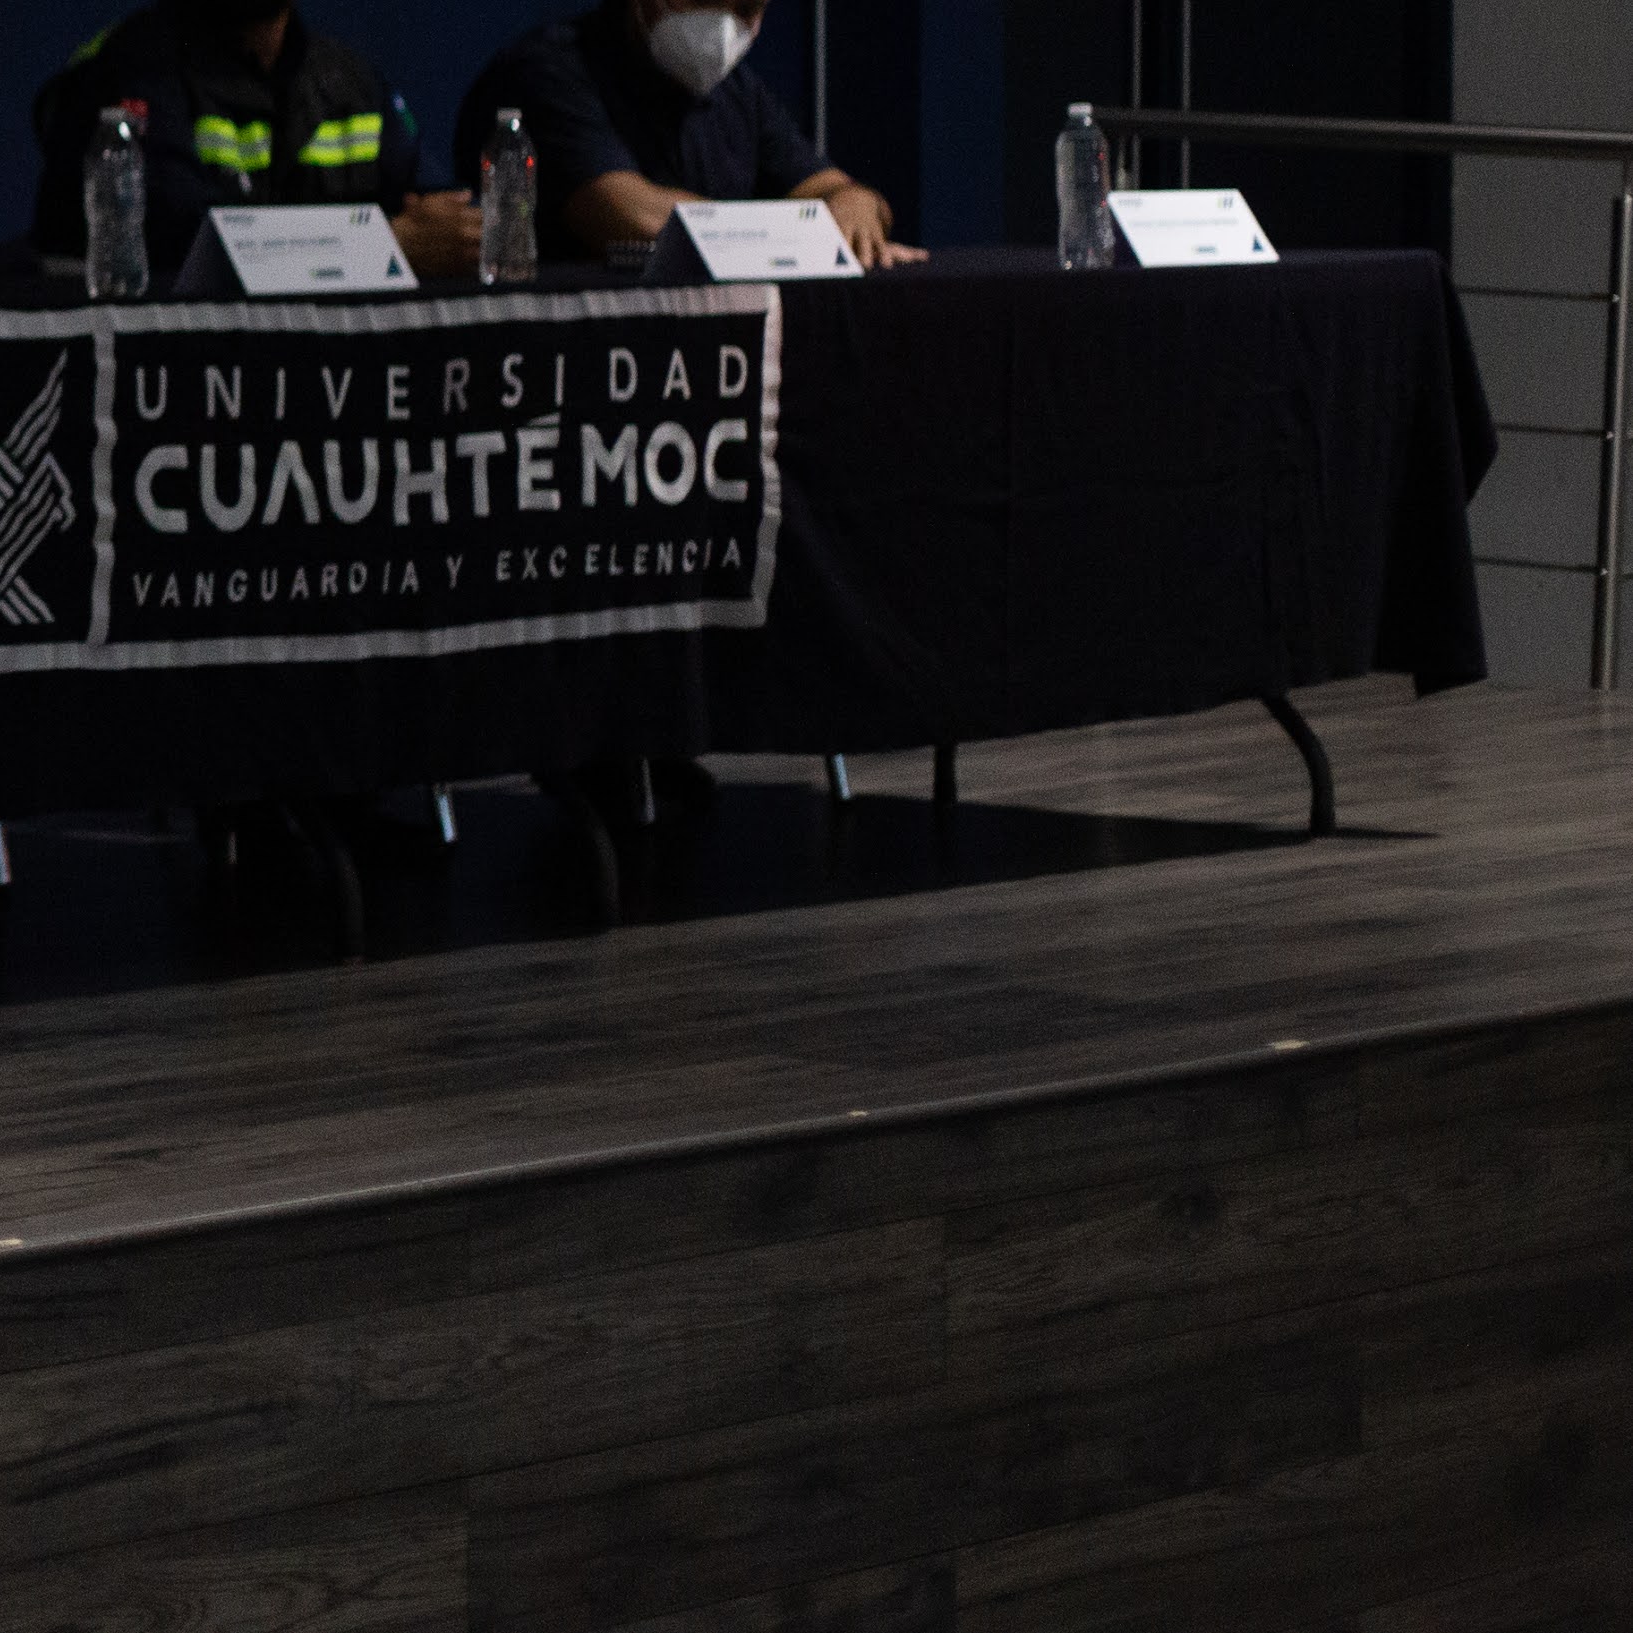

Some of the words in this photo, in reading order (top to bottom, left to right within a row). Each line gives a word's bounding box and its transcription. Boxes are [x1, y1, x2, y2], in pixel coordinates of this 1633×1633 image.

[135, 344, 749, 421] UNIVERSIDAD
[134, 412, 750, 536] CUAUHTÉMOC
[133, 559, 421, 609] VANGUARDIA
[445, 551, 464, 591] Y
[494, 536, 743, 584] EXCELENCIA
